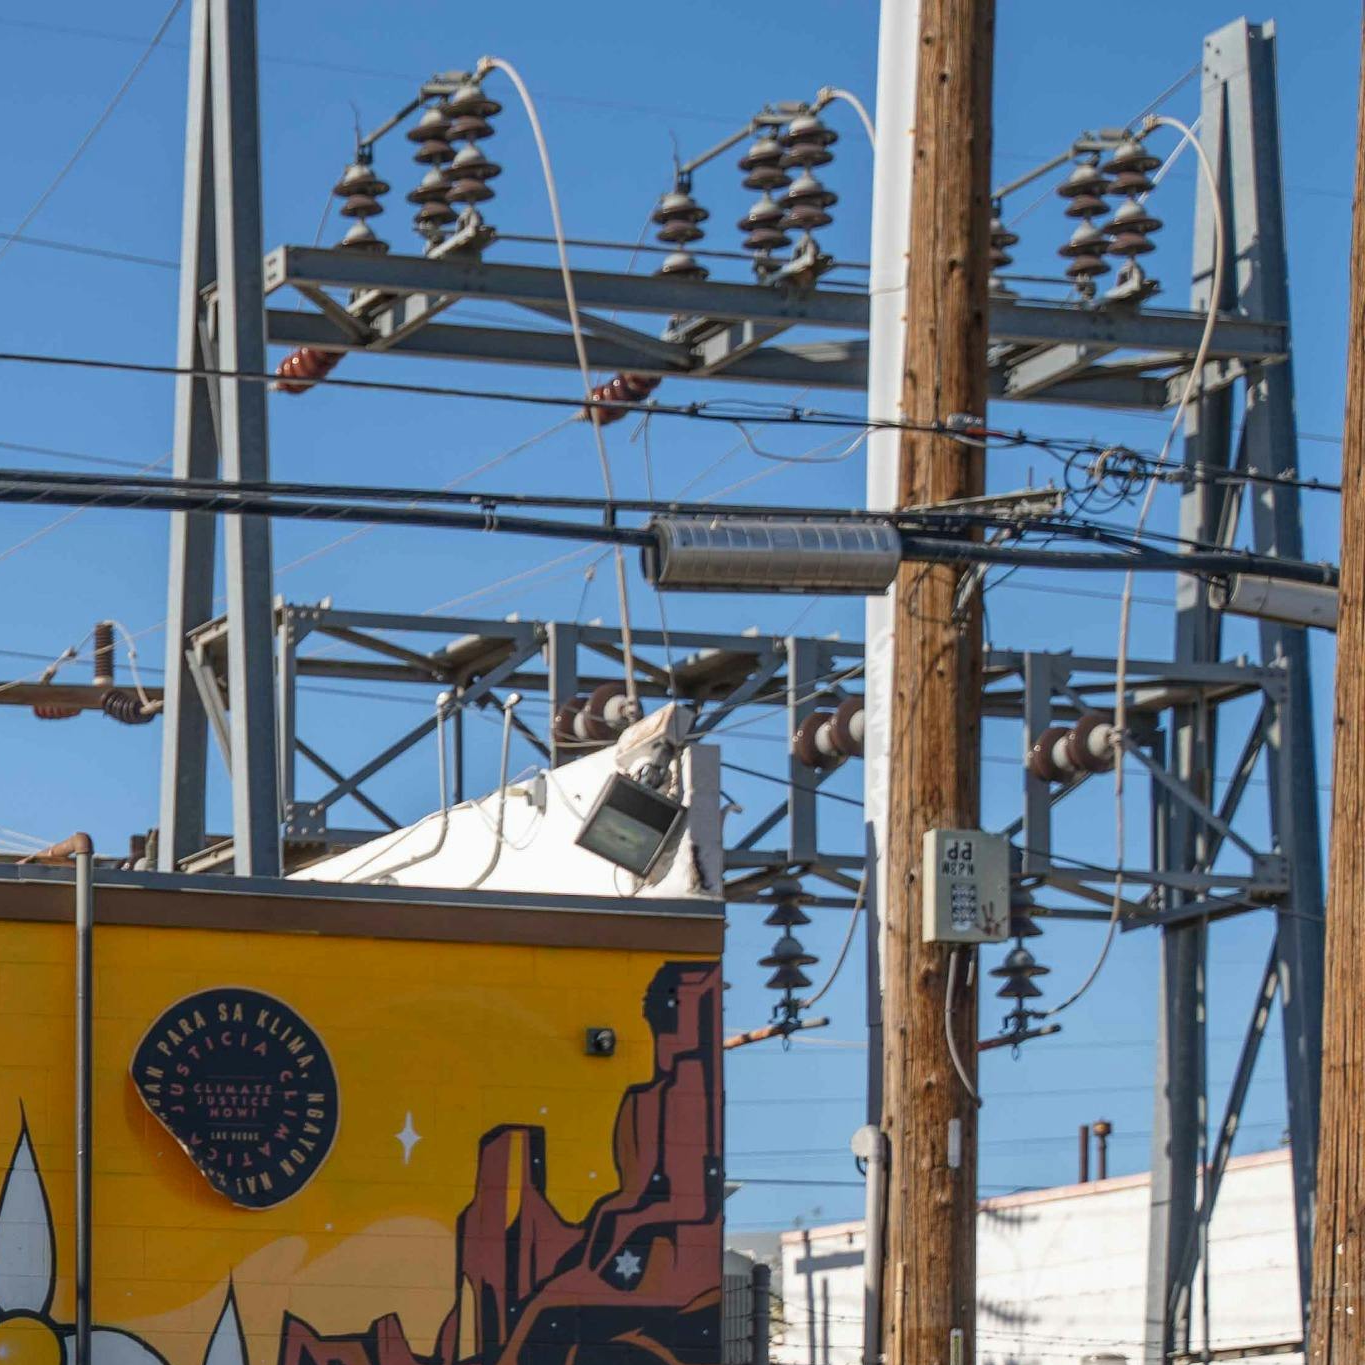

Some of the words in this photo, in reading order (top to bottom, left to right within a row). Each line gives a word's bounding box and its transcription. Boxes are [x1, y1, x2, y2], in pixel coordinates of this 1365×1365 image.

[169, 1031, 269, 1114] JUSTICIA
[157, 1009, 207, 1057] PARA
[217, 1002, 244, 1022] SA
[280, 1092, 326, 1177] NGAYON
[193, 1082, 273, 1095] CLIMATE
[196, 1095, 271, 1107] JUSTICE
[209, 1107, 258, 1118] NOW!
